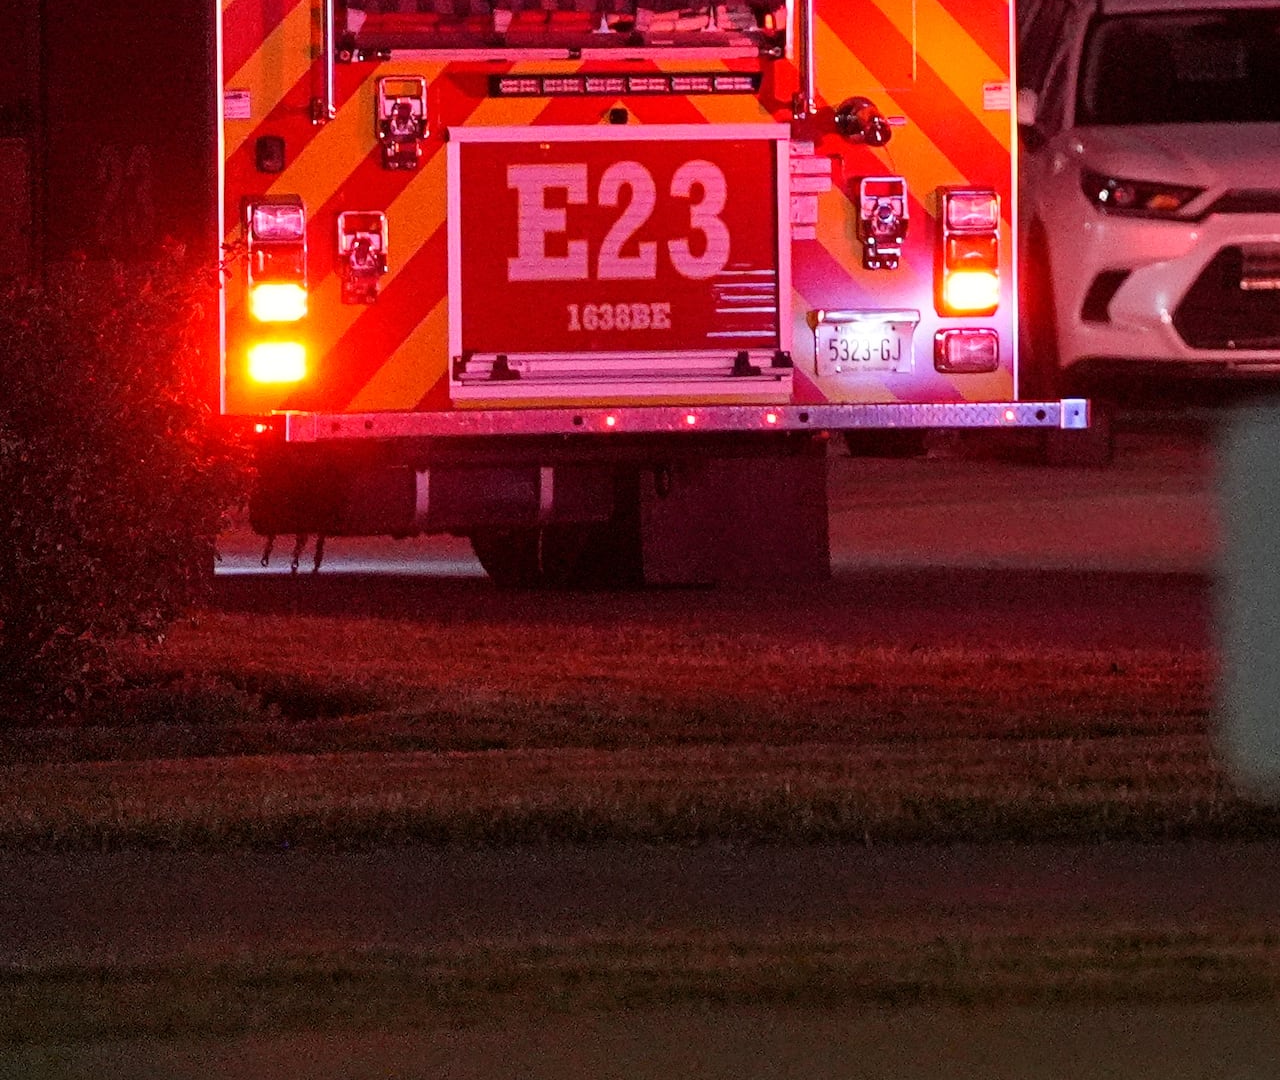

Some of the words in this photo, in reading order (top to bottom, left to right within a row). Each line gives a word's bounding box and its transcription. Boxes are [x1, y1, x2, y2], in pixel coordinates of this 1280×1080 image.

[507, 159, 731, 281] E23
[567, 302, 671, 332] 1638BE
[829, 338, 901, 361] 5323-GJ
